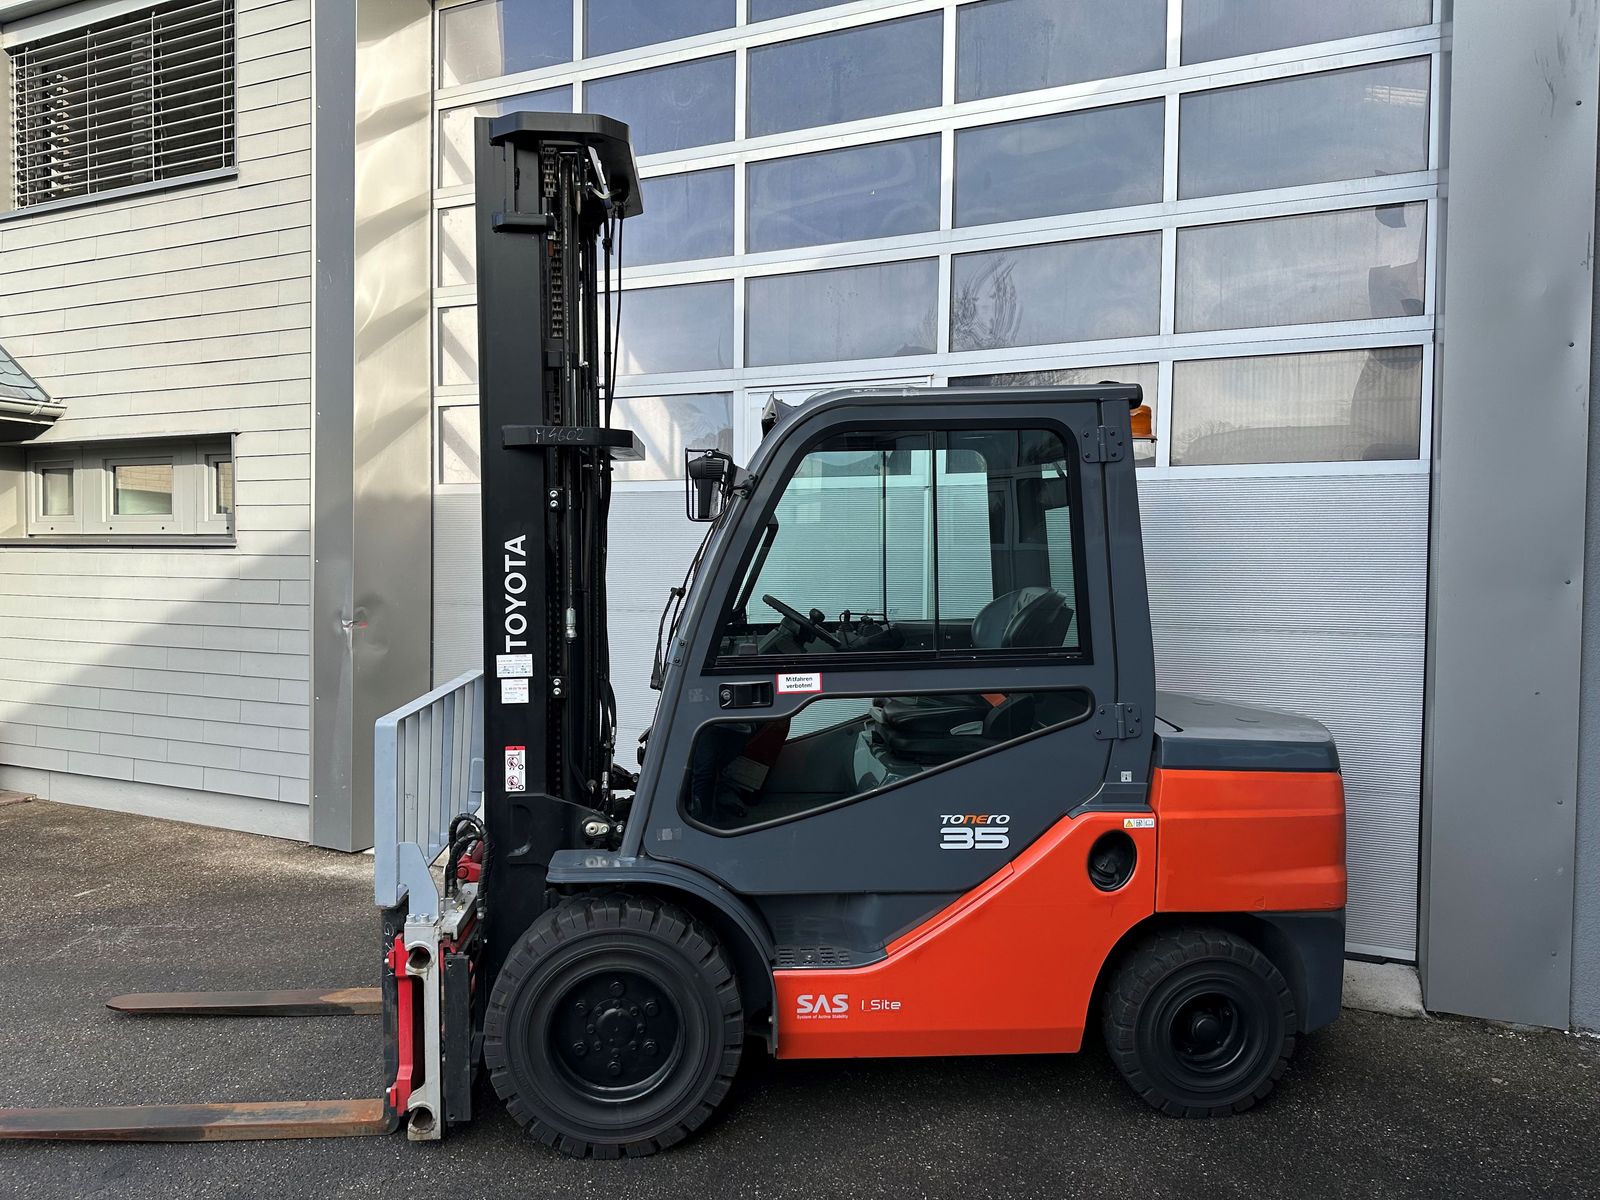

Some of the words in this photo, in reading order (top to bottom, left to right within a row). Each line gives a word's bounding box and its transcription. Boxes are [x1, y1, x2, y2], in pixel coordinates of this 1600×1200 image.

[504, 534, 528, 653] TOYOTA
[940, 827, 1009, 850] 35
[796, 994, 849, 1014] SAS
